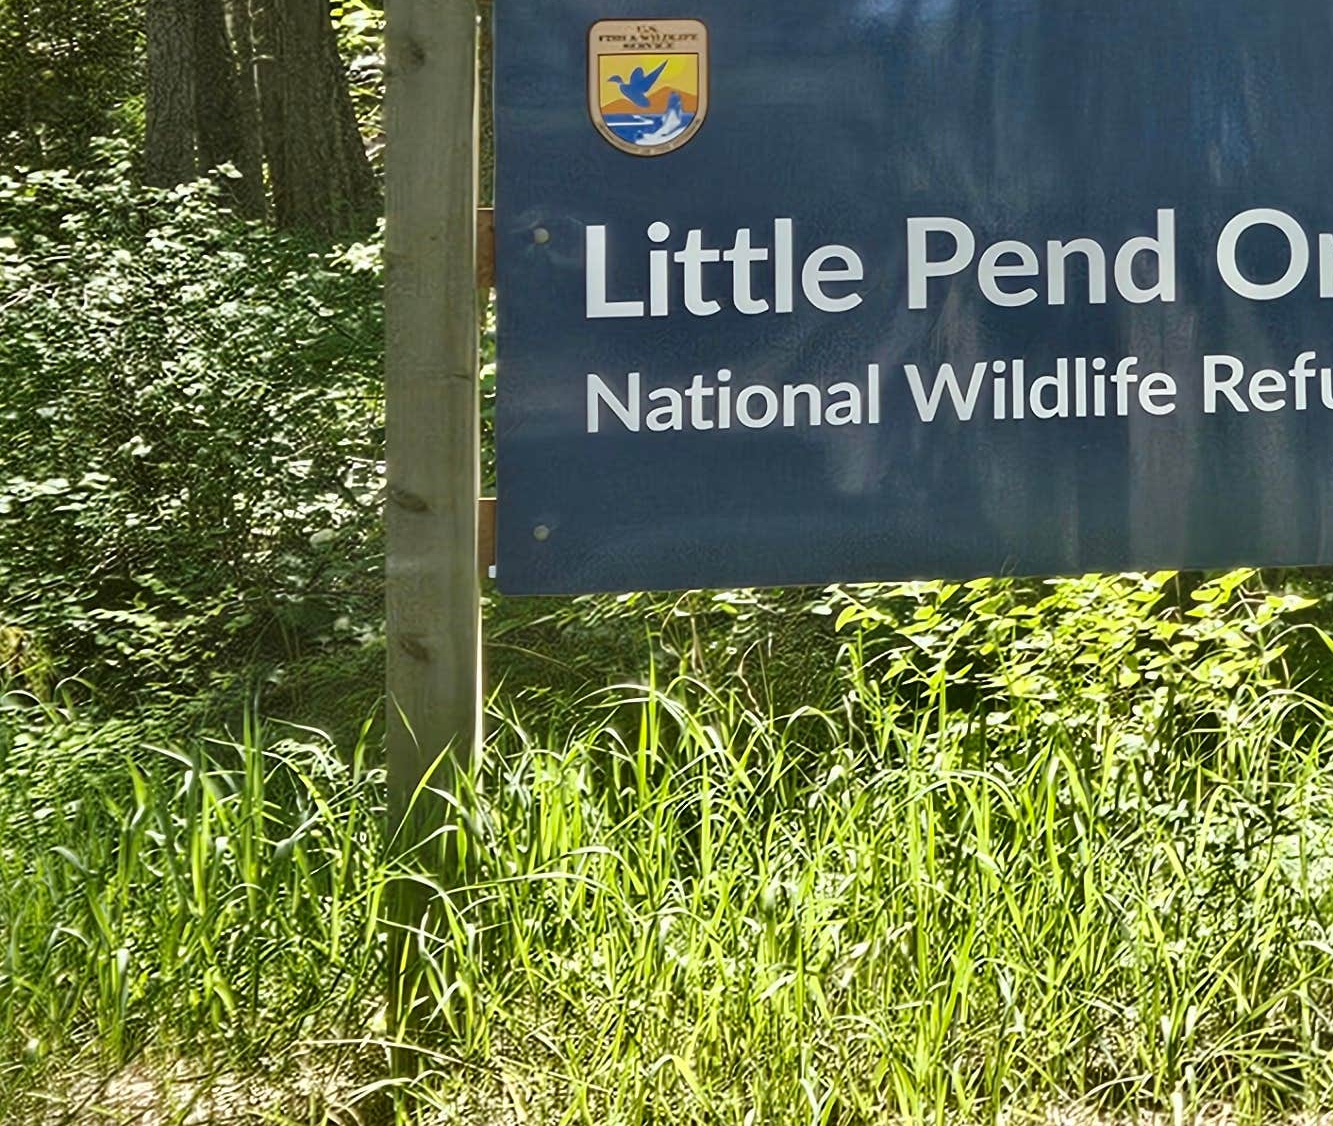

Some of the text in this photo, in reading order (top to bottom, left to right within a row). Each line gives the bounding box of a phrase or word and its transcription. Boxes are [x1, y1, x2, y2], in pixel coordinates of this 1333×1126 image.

[585, 216, 865, 319] Little
[905, 207, 1177, 311] Pend
[586, 362, 881, 434] National
[902, 355, 1178, 423] Wildlife
